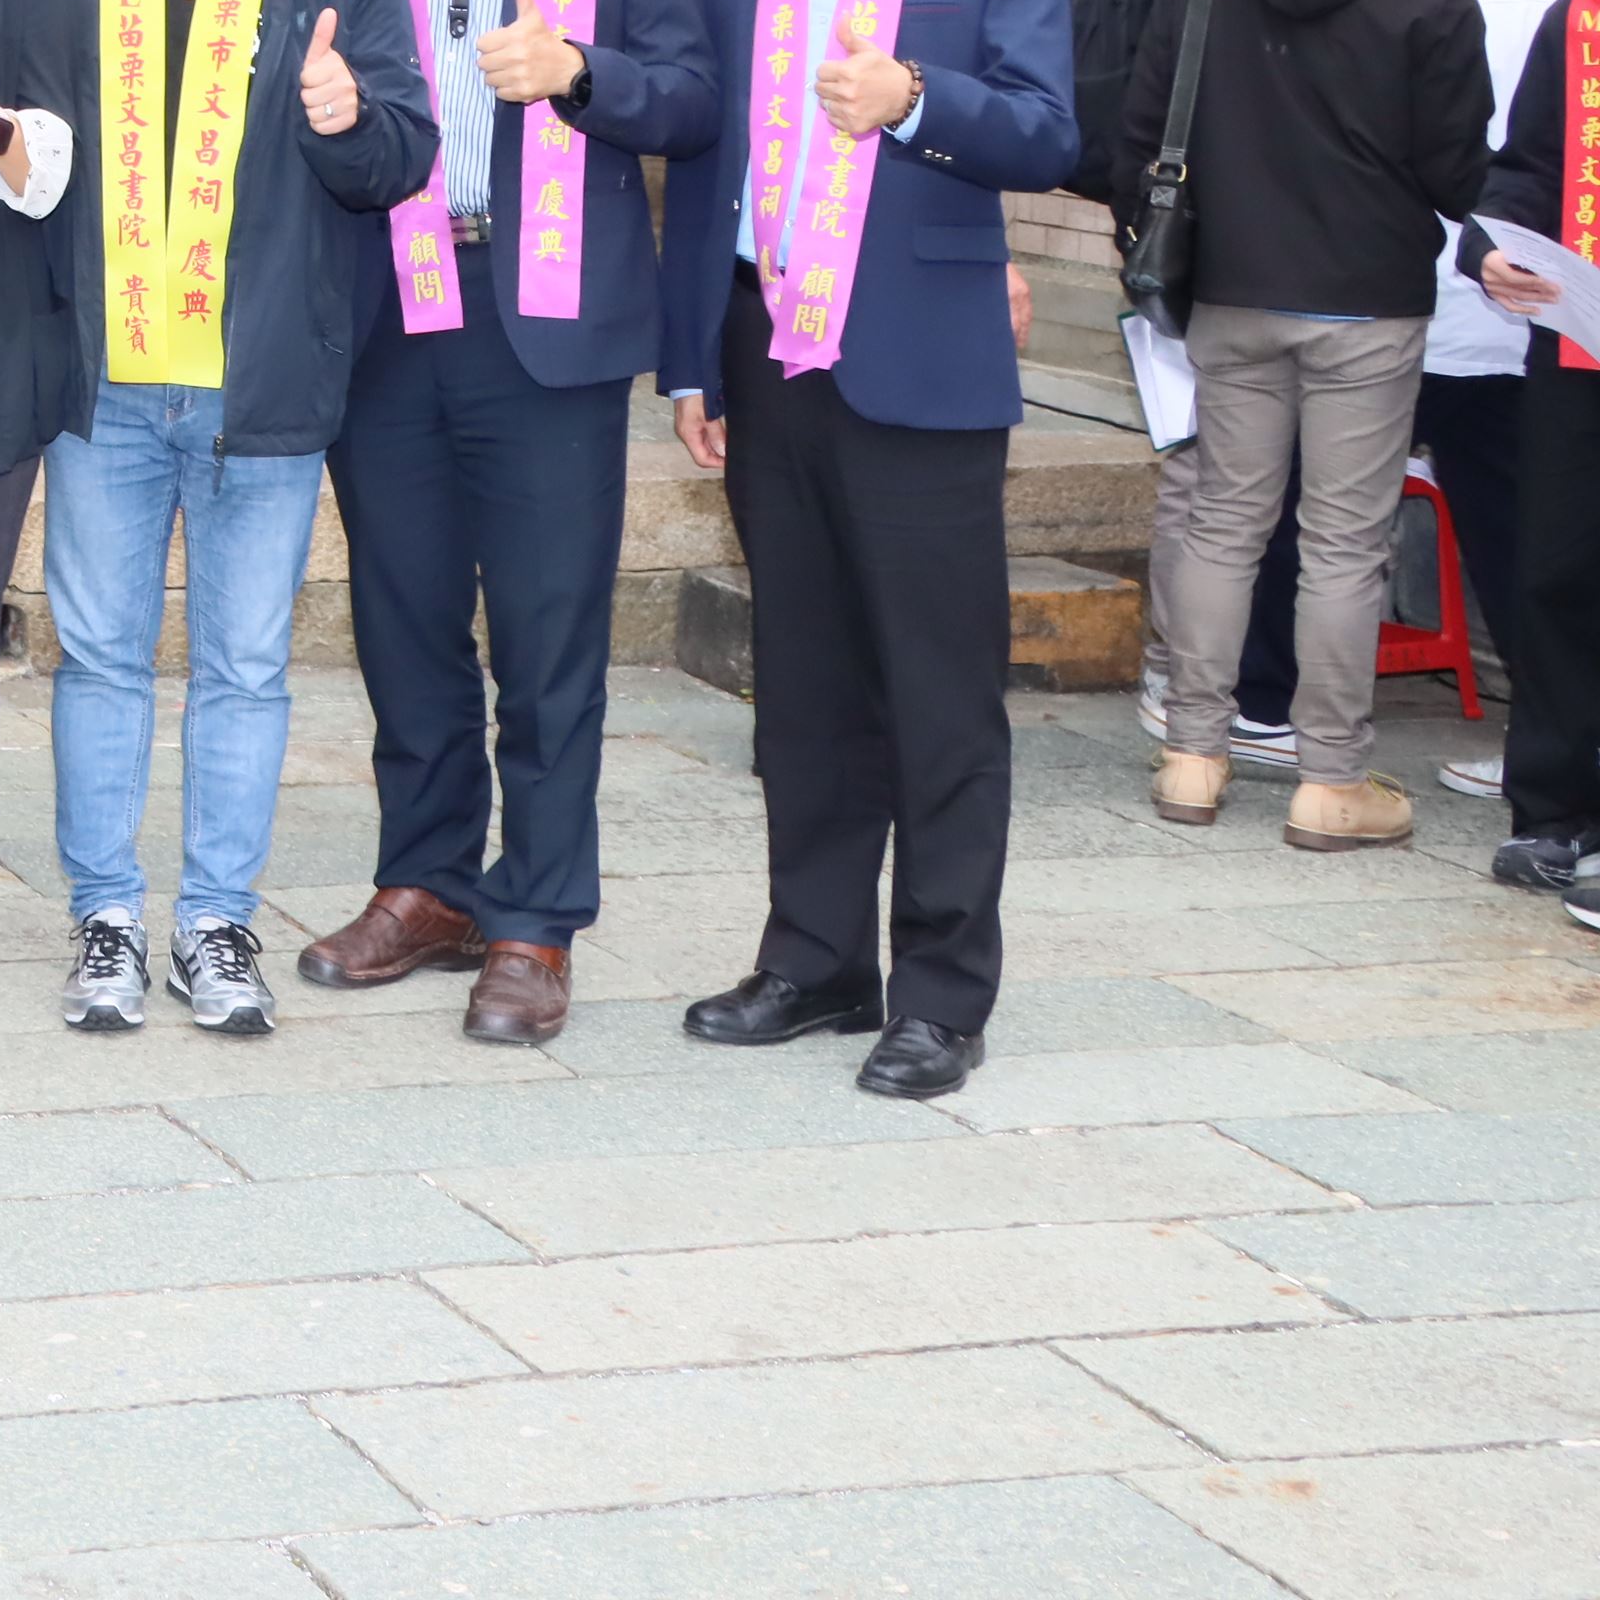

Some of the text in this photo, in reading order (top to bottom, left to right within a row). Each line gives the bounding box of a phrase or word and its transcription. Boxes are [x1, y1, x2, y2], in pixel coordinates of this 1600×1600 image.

[533, 177, 572, 263] 慶典
[177, 238, 218, 324] 慶典
[407, 230, 445, 307] 顧問
[791, 262, 837, 343] 顧問
[119, 273, 150, 357] 貴賓
